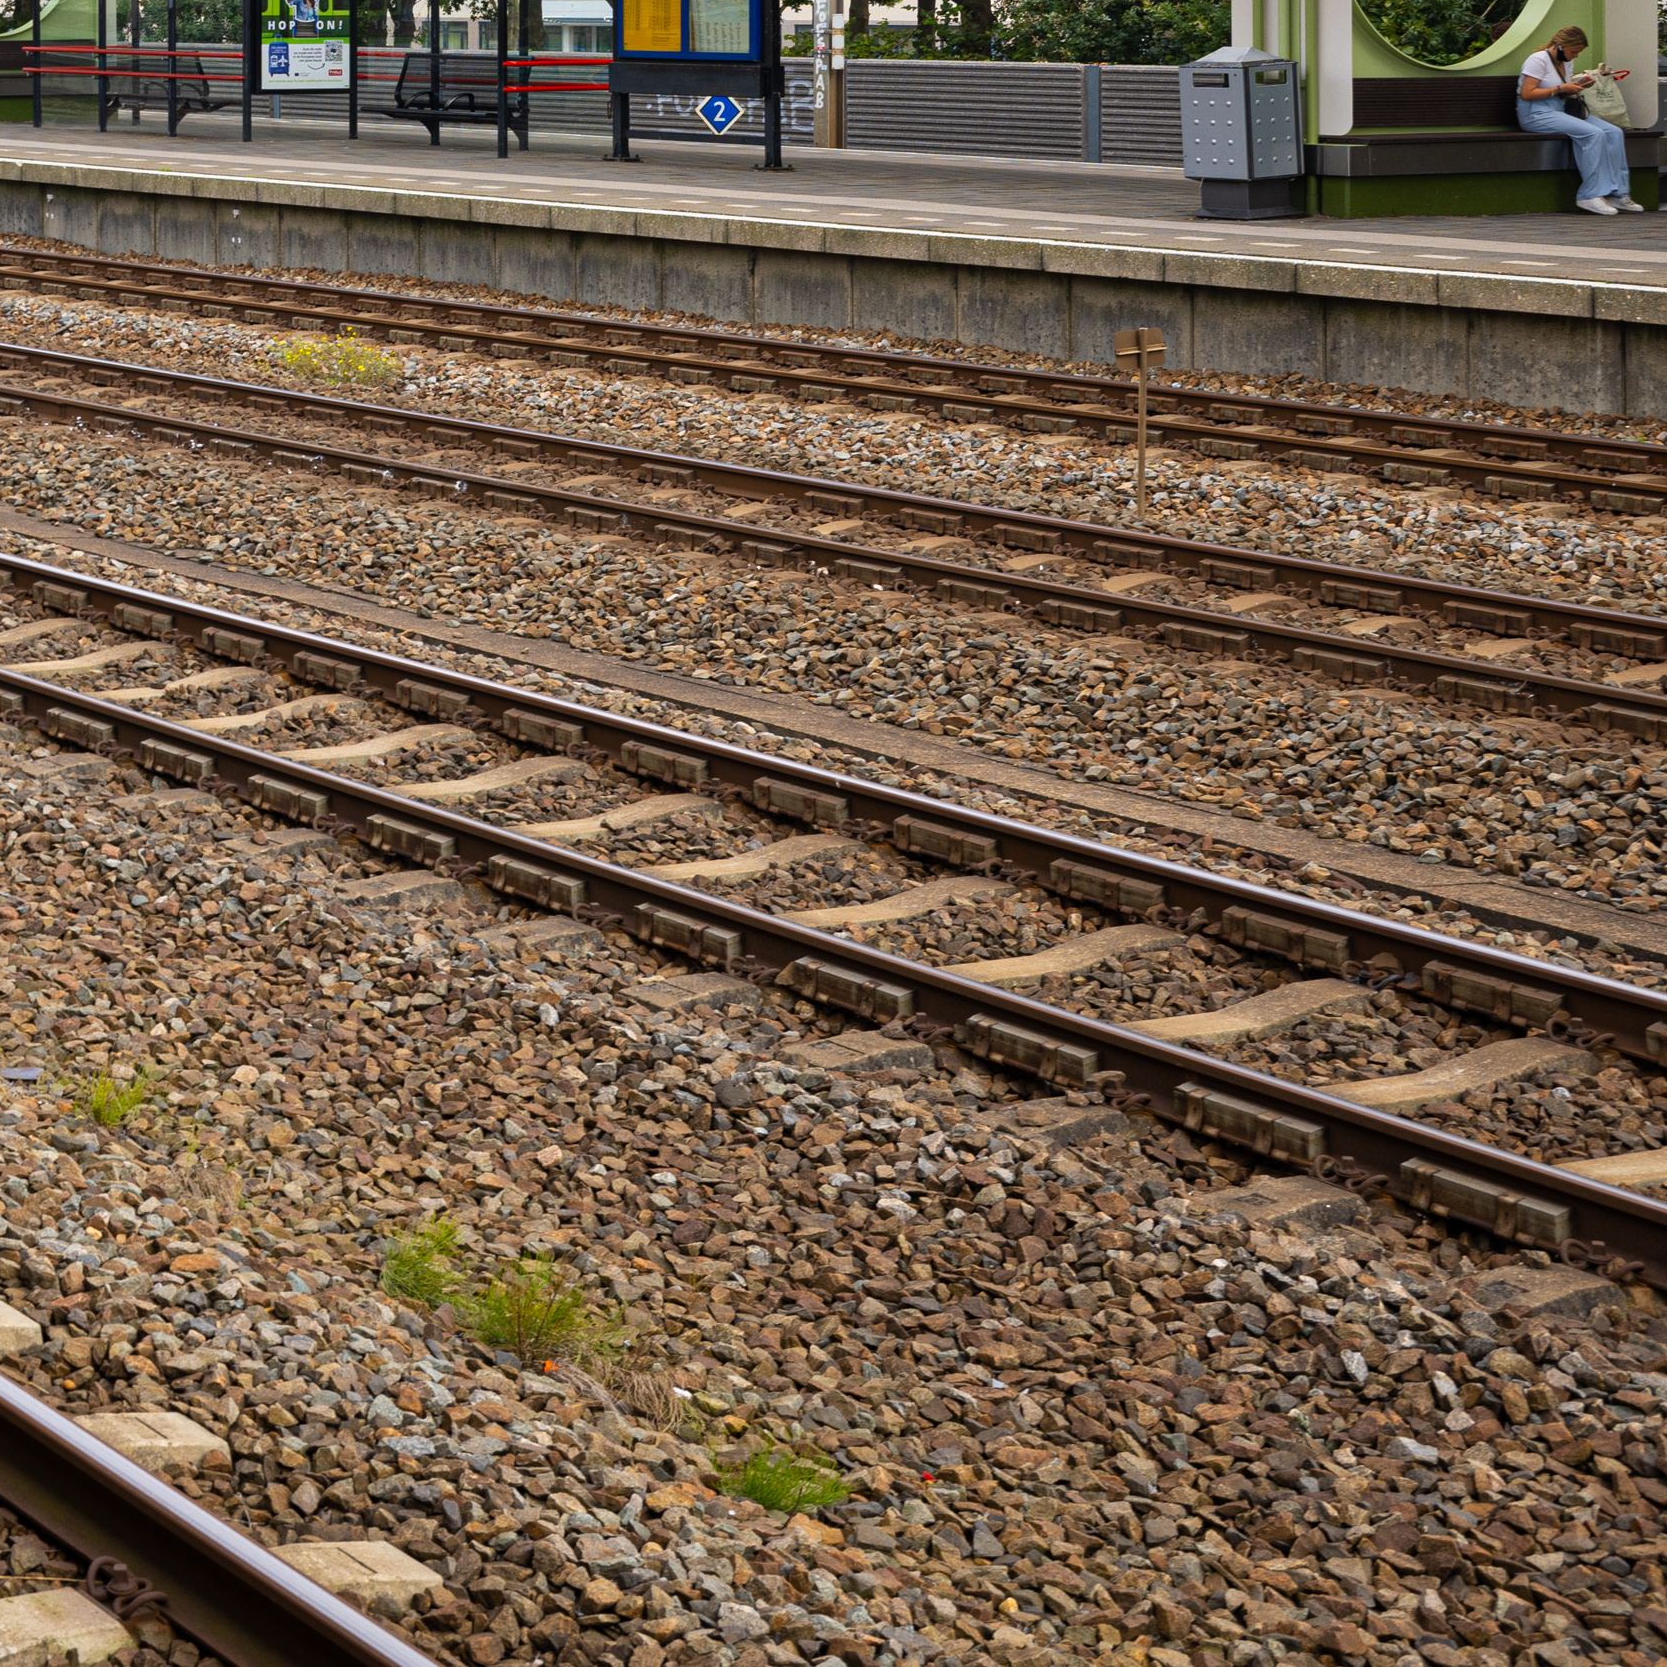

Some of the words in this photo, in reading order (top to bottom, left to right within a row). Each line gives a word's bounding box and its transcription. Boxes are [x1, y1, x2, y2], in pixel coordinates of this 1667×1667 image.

[268, 21, 296, 30] HOP
[316, 20, 343, 30] ON!
[713, 101, 726, 122] 2
